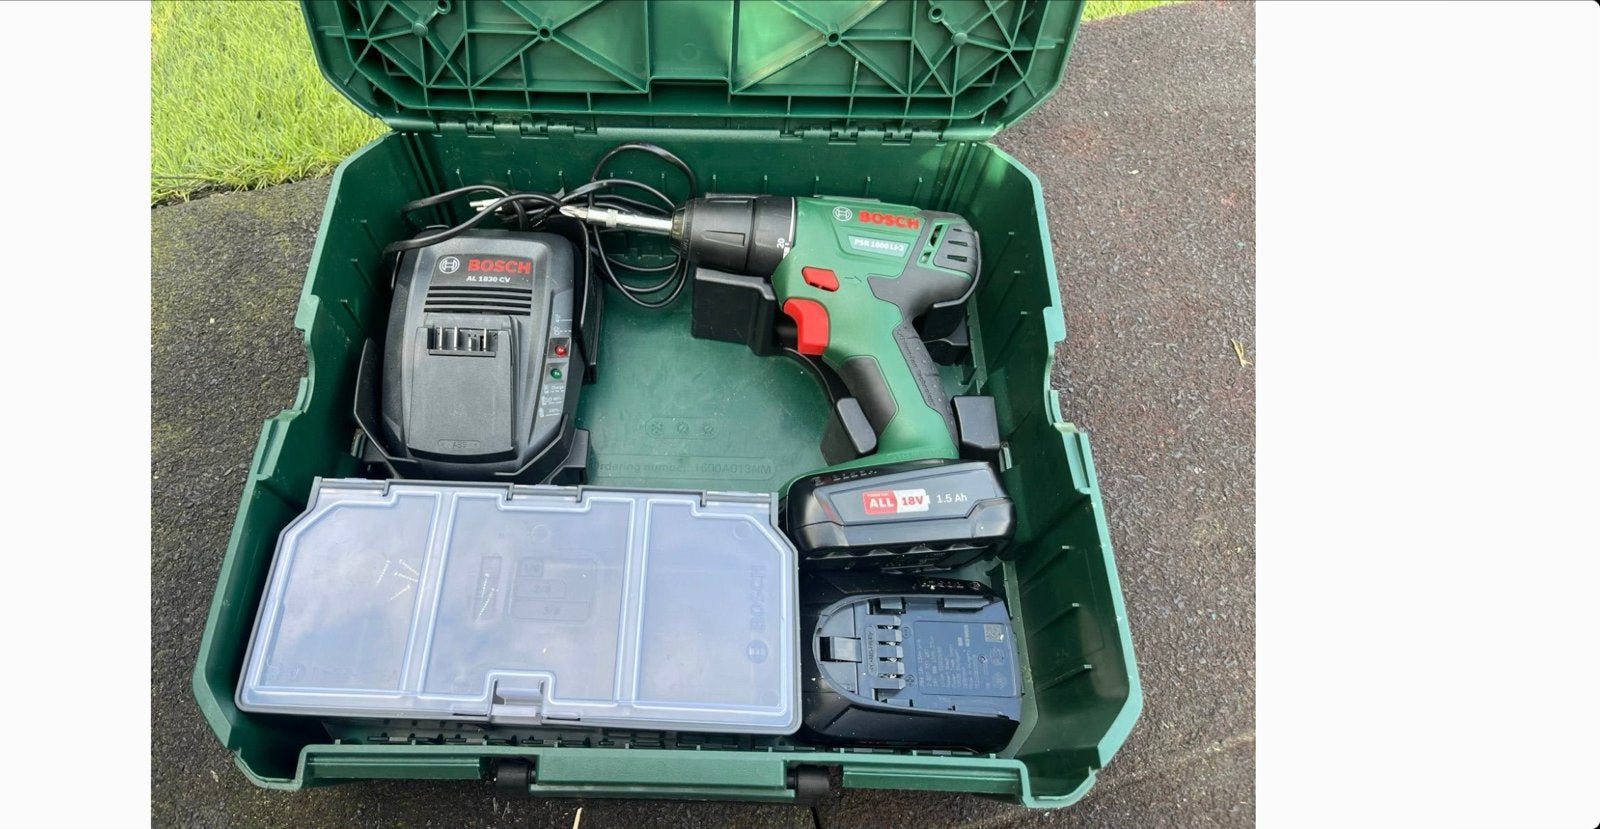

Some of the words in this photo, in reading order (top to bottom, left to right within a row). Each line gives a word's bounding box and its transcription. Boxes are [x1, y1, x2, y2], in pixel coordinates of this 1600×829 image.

[858, 210, 919, 230] BOSCH
[776, 237, 785, 249] 20
[854, 238, 869, 247] PSR
[871, 241, 889, 249] 1800
[468, 259, 531, 275] BOSCH
[478, 275, 498, 283] 1830
[869, 497, 895, 509] ALL
[902, 495, 924, 506] 18V
[936, 494, 953, 504] 1.5
[954, 493, 968, 503] Ah
